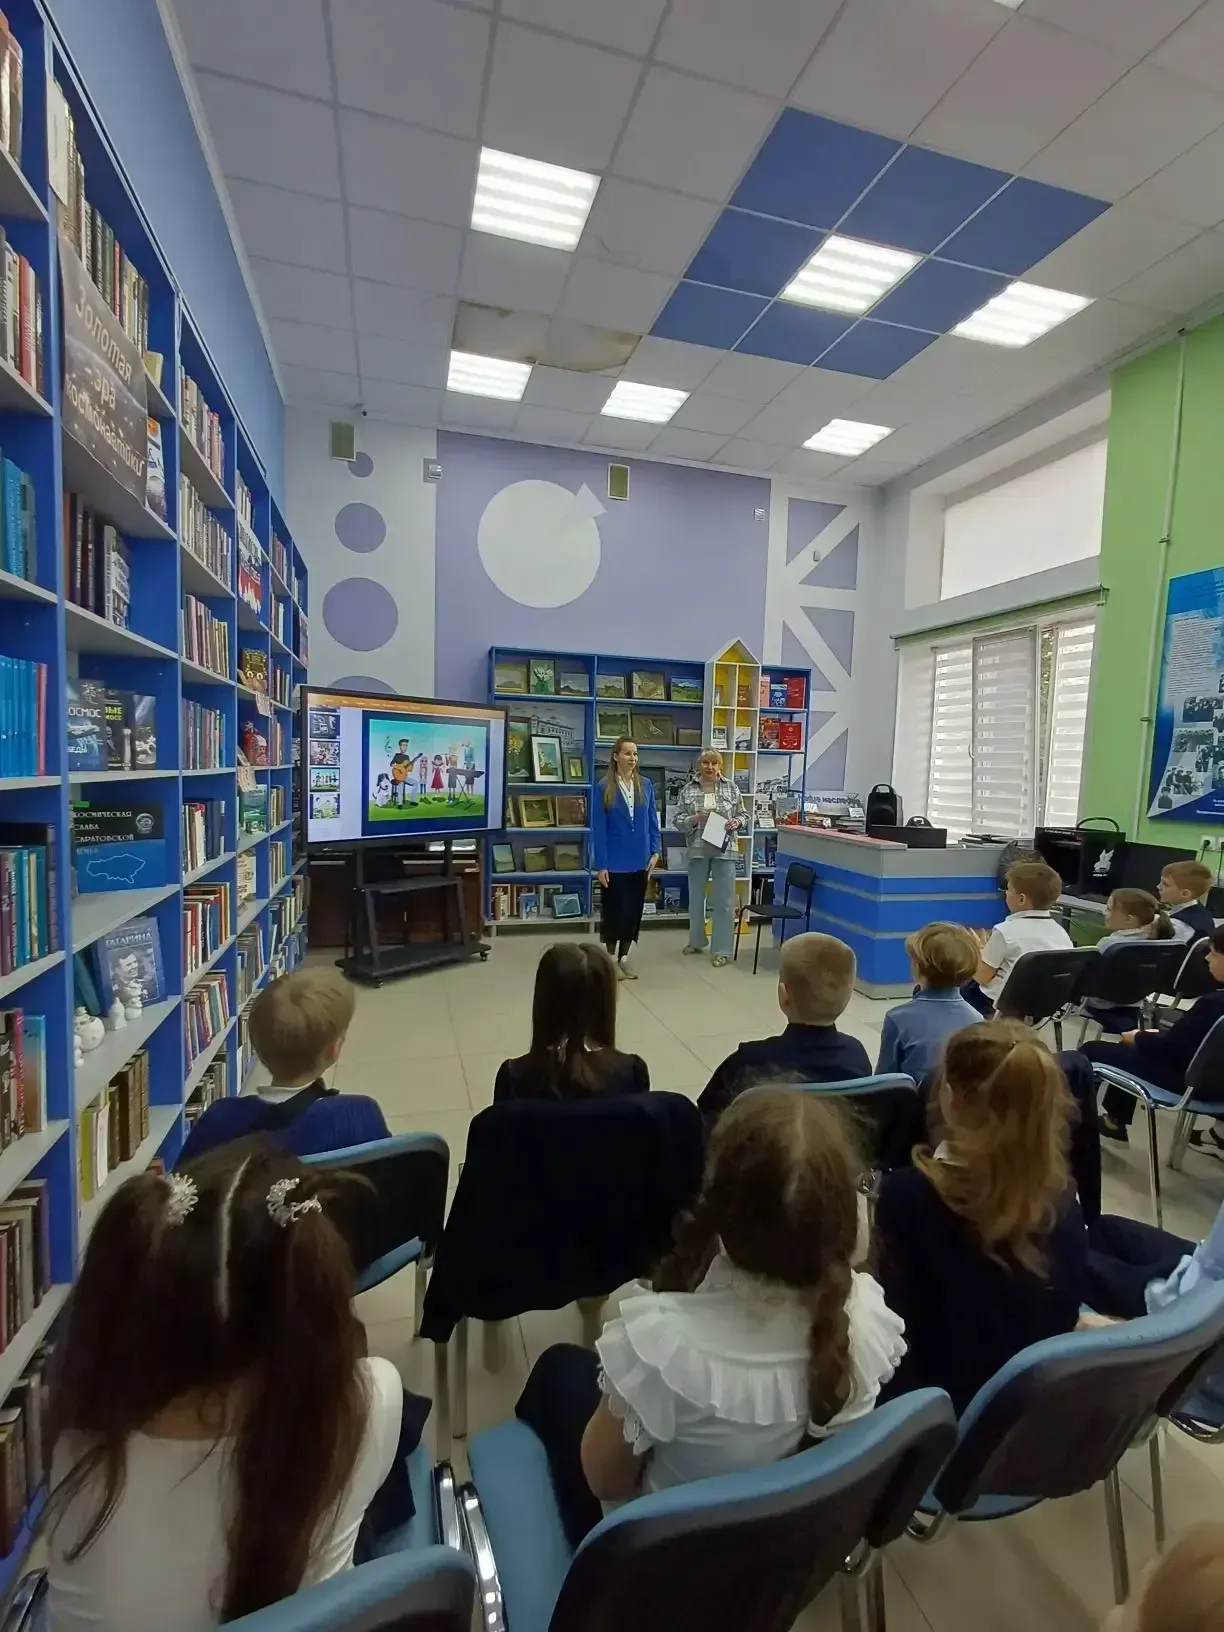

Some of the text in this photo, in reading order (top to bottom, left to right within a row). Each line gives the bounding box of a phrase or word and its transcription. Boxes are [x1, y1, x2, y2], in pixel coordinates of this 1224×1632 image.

[75, 285, 133, 385] Золотая
[92, 368, 117, 410] эра
[65, 373, 145, 477] космонавтики
[67, 706, 102, 718] ОСМОС
[73, 823, 100, 831] СЛАВА
[75, 833, 135, 843] САРАТОВСКОЙ
